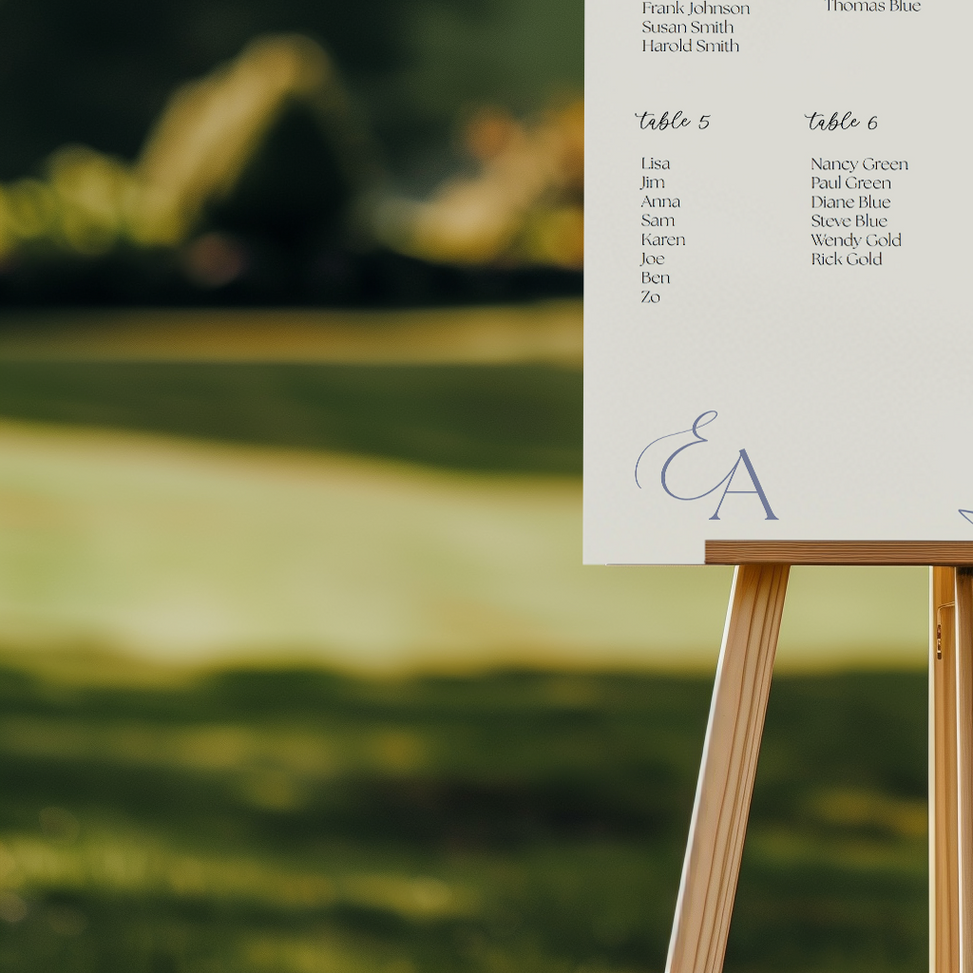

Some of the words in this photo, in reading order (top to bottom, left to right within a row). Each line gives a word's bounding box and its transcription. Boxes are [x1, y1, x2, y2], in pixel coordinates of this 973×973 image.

[643, 0, 684, 14] Frank
[688, 0, 750, 16] Johnson
[642, 20, 687, 34] Susan
[691, 19, 734, 34] Smith
[643, 38, 692, 52] Harold
[696, 38, 739, 53] Smith
[634, 110, 691, 131] table
[698, 115, 711, 130] 5
[804, 111, 860, 131] table
[868, 116, 877, 130] 6
[642, 157, 670, 170] Lisa
[811, 157, 859, 173] Nancy
[862, 157, 908, 171] Green
[639, 176, 665, 190] Jim
[812, 175, 841, 189] Paul
[845, 176, 891, 189] Green
[641, 195, 680, 208] Anna
[812, 196, 855, 208] Diane
[859, 194, 891, 209] Blue
[641, 214, 675, 227] Sam
[811, 214, 851, 227] Steve
[856, 213, 888, 227] Blue
[642, 233, 685, 246] Karen
[811, 232, 862, 249] Wendy
[866, 232, 901, 247] Gold
[639, 252, 665, 267] Joe
[812, 251, 843, 266] Rick
[846, 251, 882, 266] Gold
[642, 271, 670, 284] Ben
[641, 290, 660, 303] Zo
